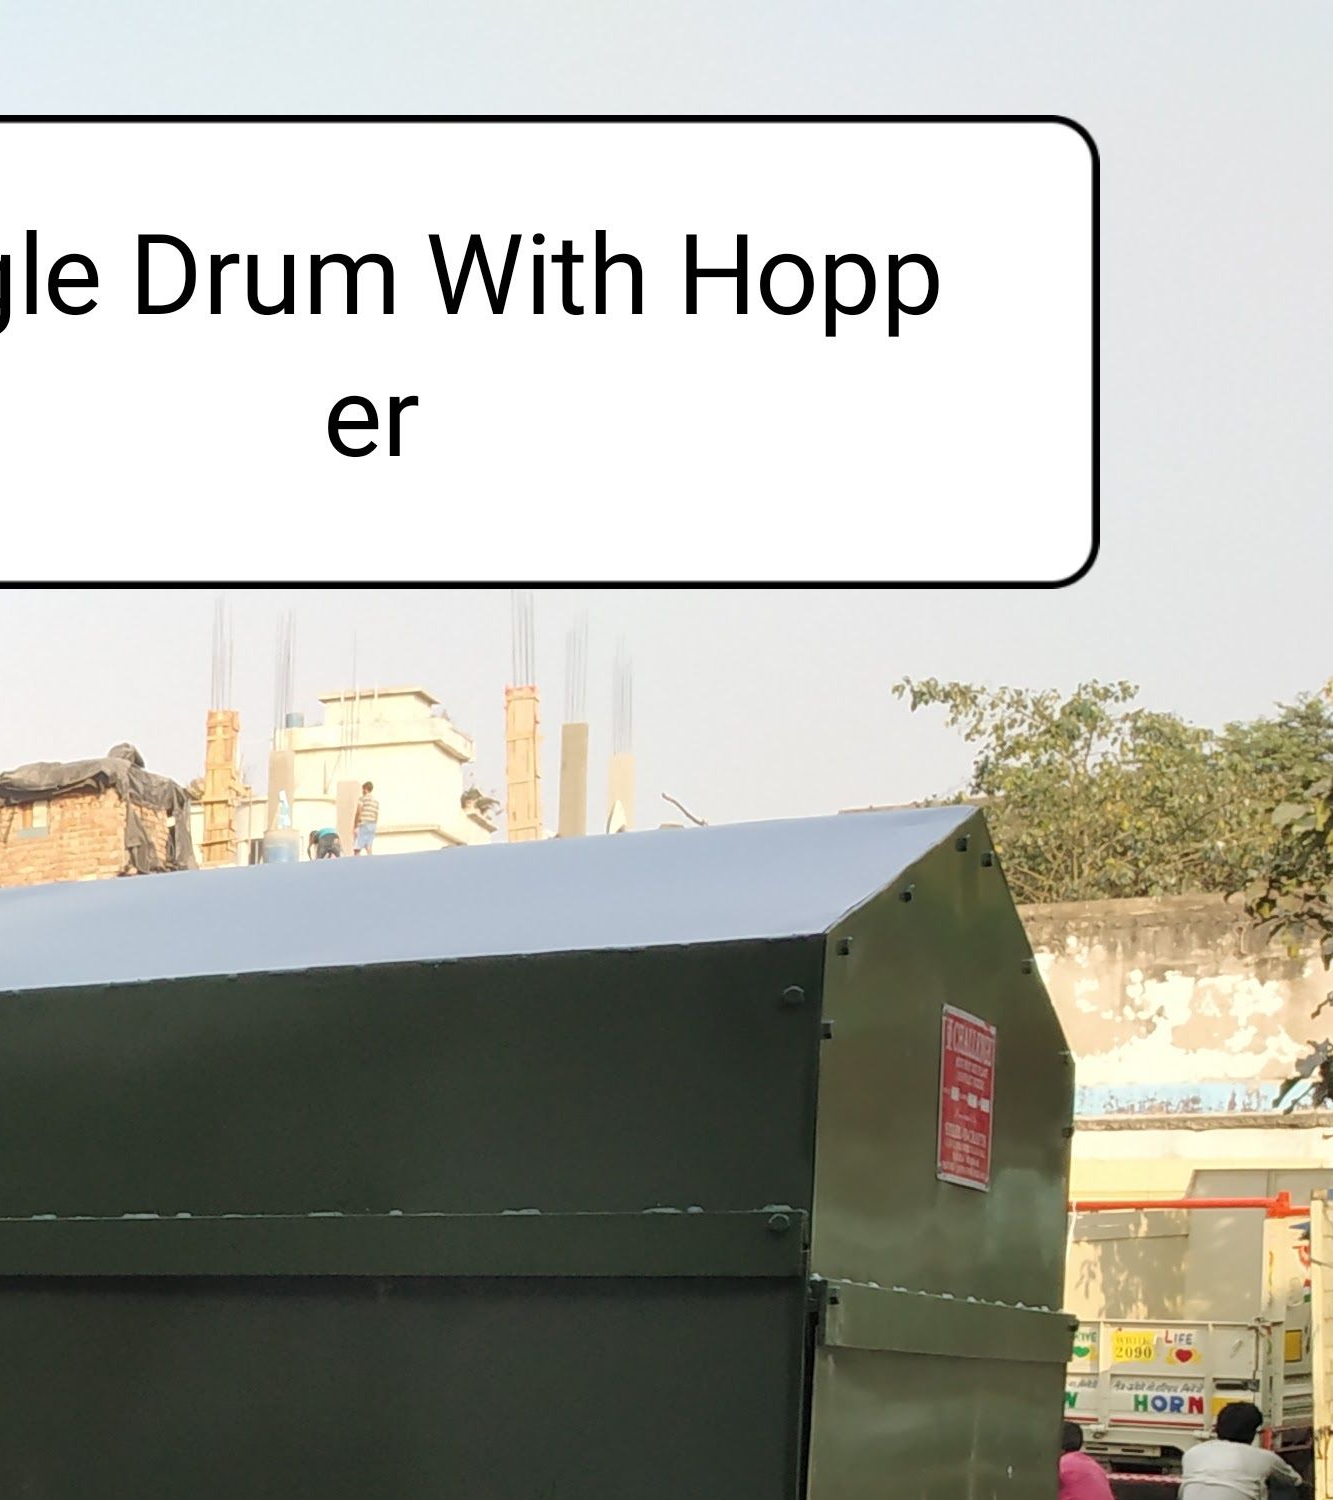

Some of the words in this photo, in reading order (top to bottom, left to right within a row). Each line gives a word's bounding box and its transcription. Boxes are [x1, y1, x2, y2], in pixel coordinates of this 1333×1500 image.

[1074, 1331, 1097, 1343] RIVE
[1164, 1329, 1193, 1346] LIFE
[1115, 1345, 1153, 1359] 2090
[1133, 1393, 1205, 1415] HORN
